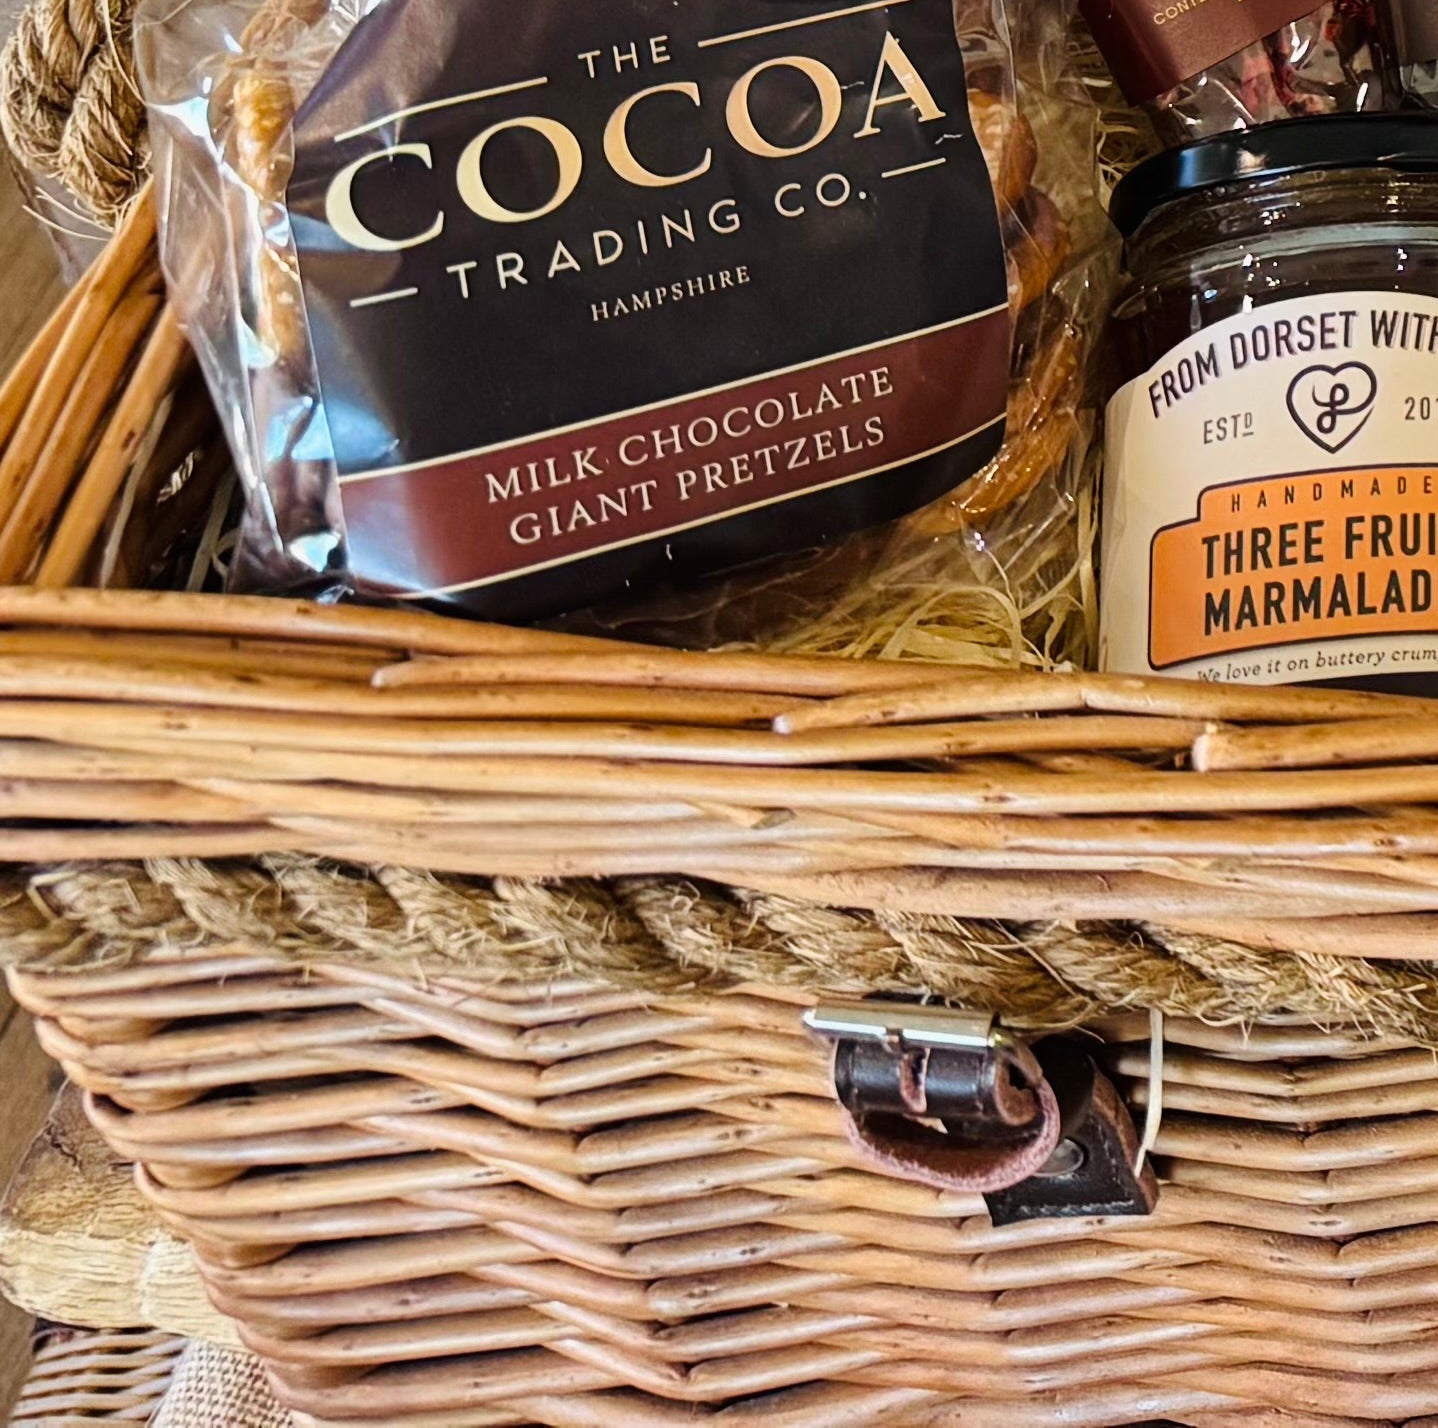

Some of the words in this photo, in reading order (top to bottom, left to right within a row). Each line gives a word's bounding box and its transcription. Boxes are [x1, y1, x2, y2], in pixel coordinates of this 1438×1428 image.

[324, 30, 946, 253] COCOA
[591, 265, 752, 322] HAMPSHIRE
[509, 480, 659, 546] GIANT
[678, 416, 889, 503] PRETZELS
[1202, 520, 1326, 579] THREE
[1315, 646, 1385, 670] buttery
